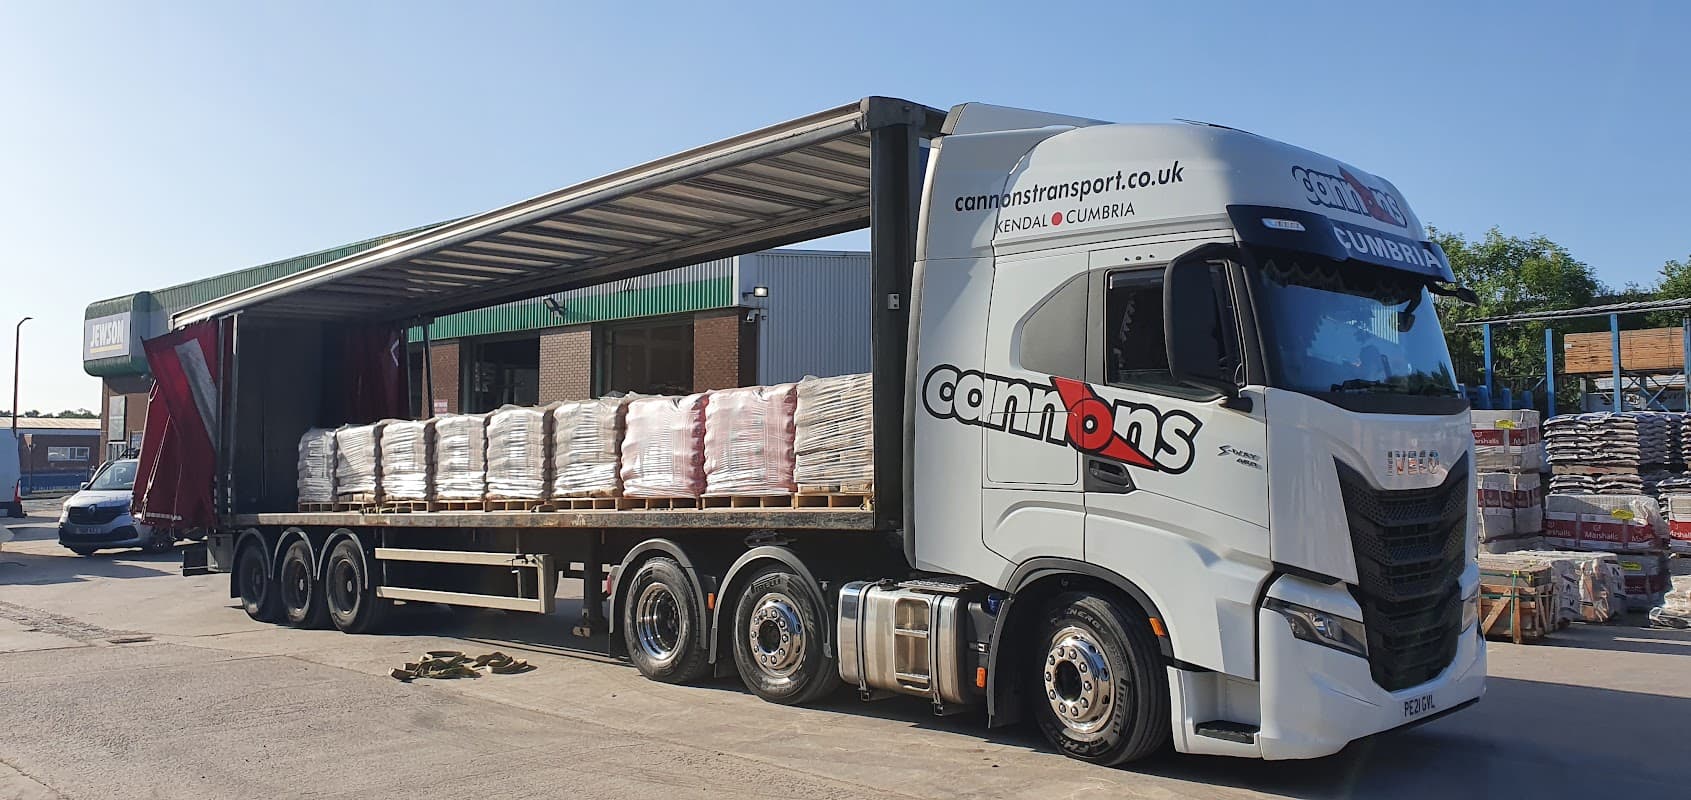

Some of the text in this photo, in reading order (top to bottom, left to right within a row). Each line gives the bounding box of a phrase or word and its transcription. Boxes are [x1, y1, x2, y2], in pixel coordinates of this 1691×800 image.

[955, 160, 1184, 212] cannonstransport.co.uk
[1292, 165, 1408, 229] cannons
[995, 201, 1135, 234] KENDAL CUMBRIA
[1333, 226, 1442, 269] CUMBRIA
[91, 319, 124, 347] JEWSON
[922, 363, 1203, 475] cannons
[1387, 450, 1440, 476] IVECO
[1584, 531, 1618, 540] Marshalls
